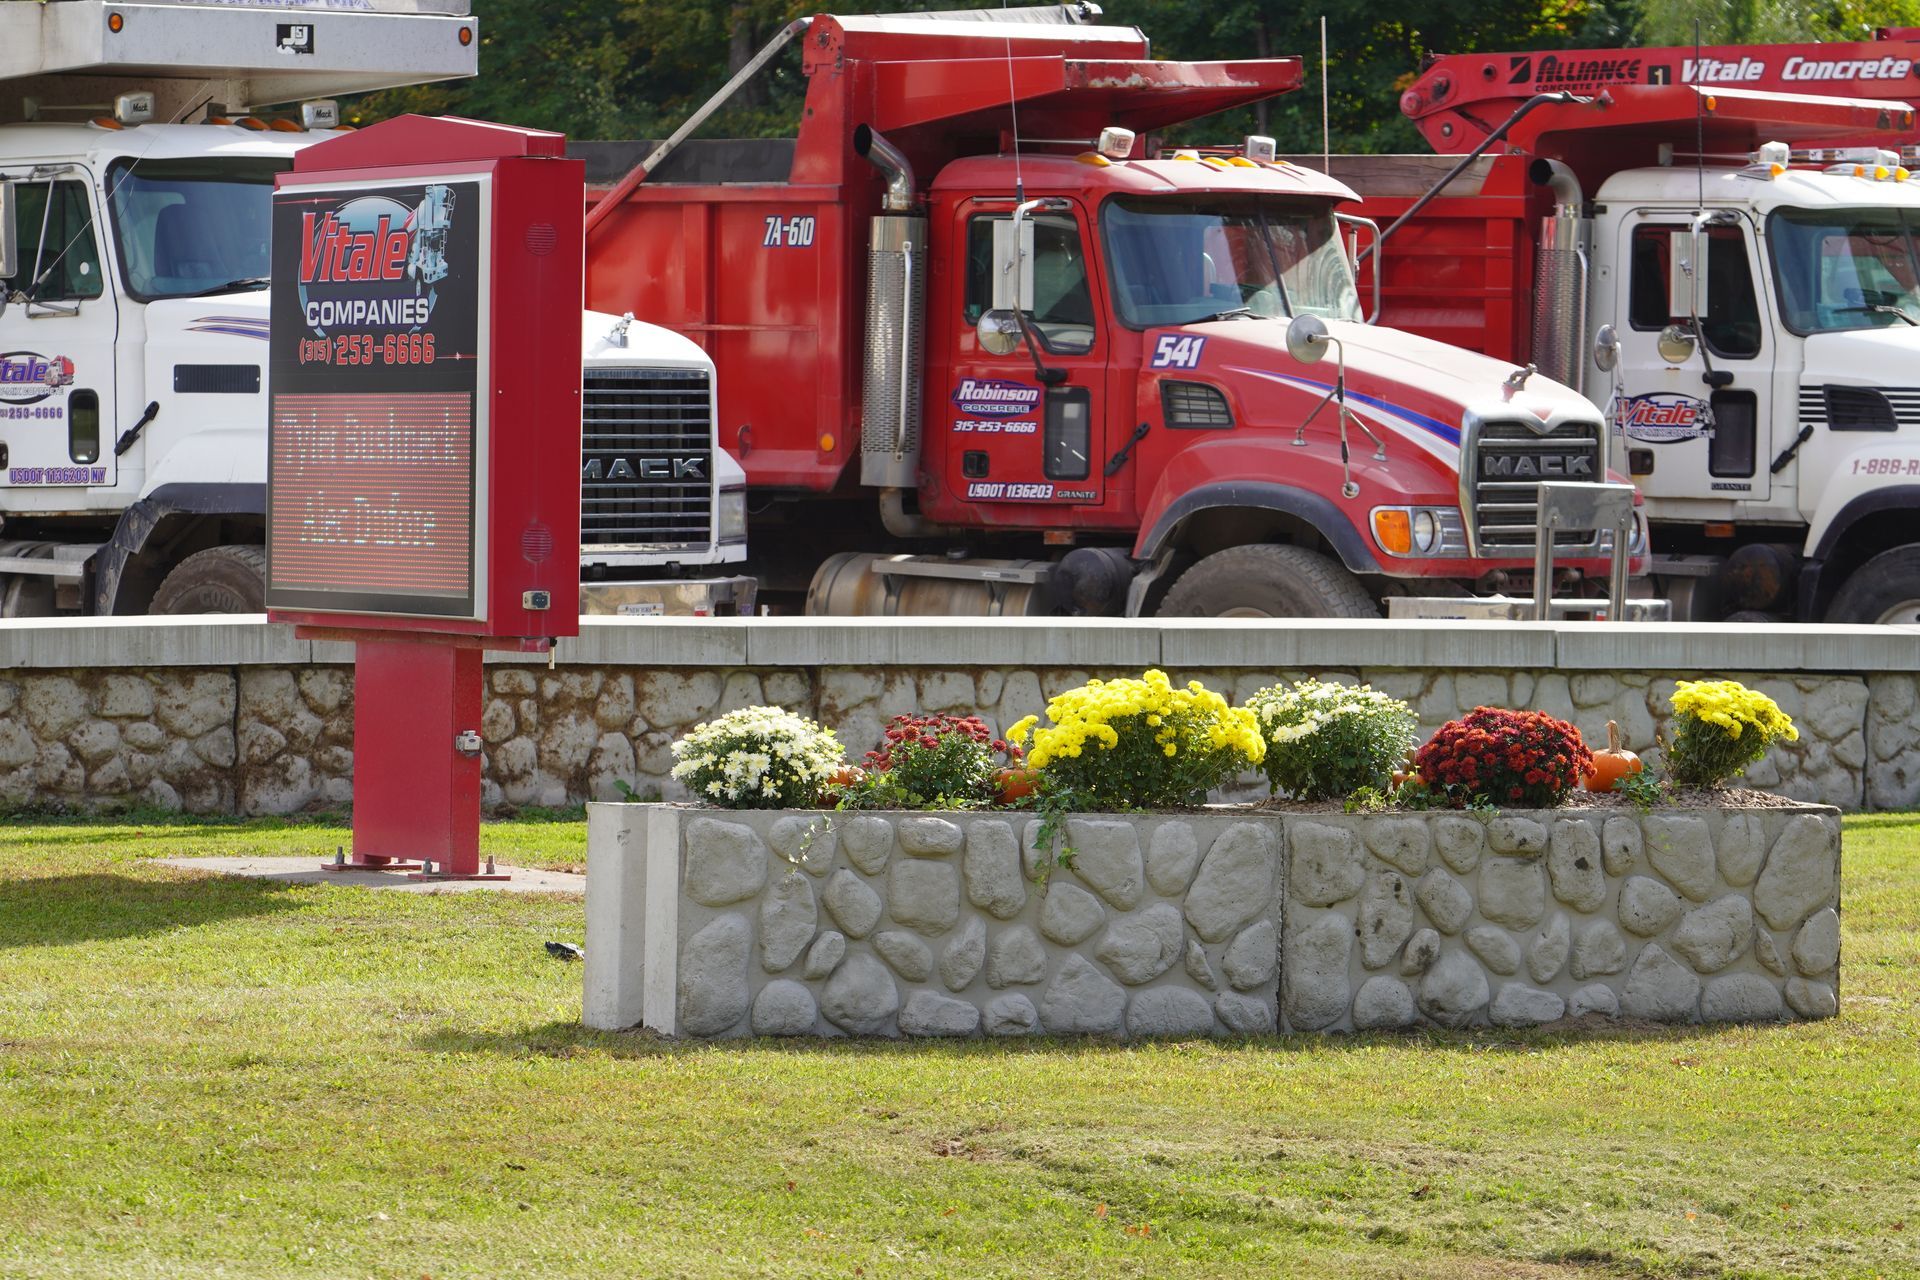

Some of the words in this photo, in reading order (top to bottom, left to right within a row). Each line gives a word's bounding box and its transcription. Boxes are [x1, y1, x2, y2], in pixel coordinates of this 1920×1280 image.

[1535, 55, 1641, 83] ALLIANCE
[1681, 57, 1765, 83] Vitale
[1781, 56, 1911, 81] Concrete
[132, 103, 148, 113] Mack
[315, 109, 332, 119] Mack
[763, 216, 815, 246] 7A-610
[301, 211, 408, 283] Vitale
[306, 298, 429, 327] COMPANIES
[299, 336, 332, 365] (315)
[336, 333, 435, 365] 253-6666
[1153, 336, 1205, 368] 541
[958, 380, 1039, 401] Robinson
[962, 404, 1030, 413] CONCRETE
[1615, 399, 1698, 426] Vitale
[953, 421, 1037, 433] 315-253-6666
[10, 468, 43, 483] USDOT
[45, 468, 89, 483] 1136203
[91, 468, 106, 483] NY
[1485, 456, 1593, 476] MACK
[1852, 459, 1920, 475] 1-888-R
[968, 484, 1005, 497] USDOT
[1006, 485, 1053, 498] 1136203
[1057, 491, 1096, 499] GRANITE
